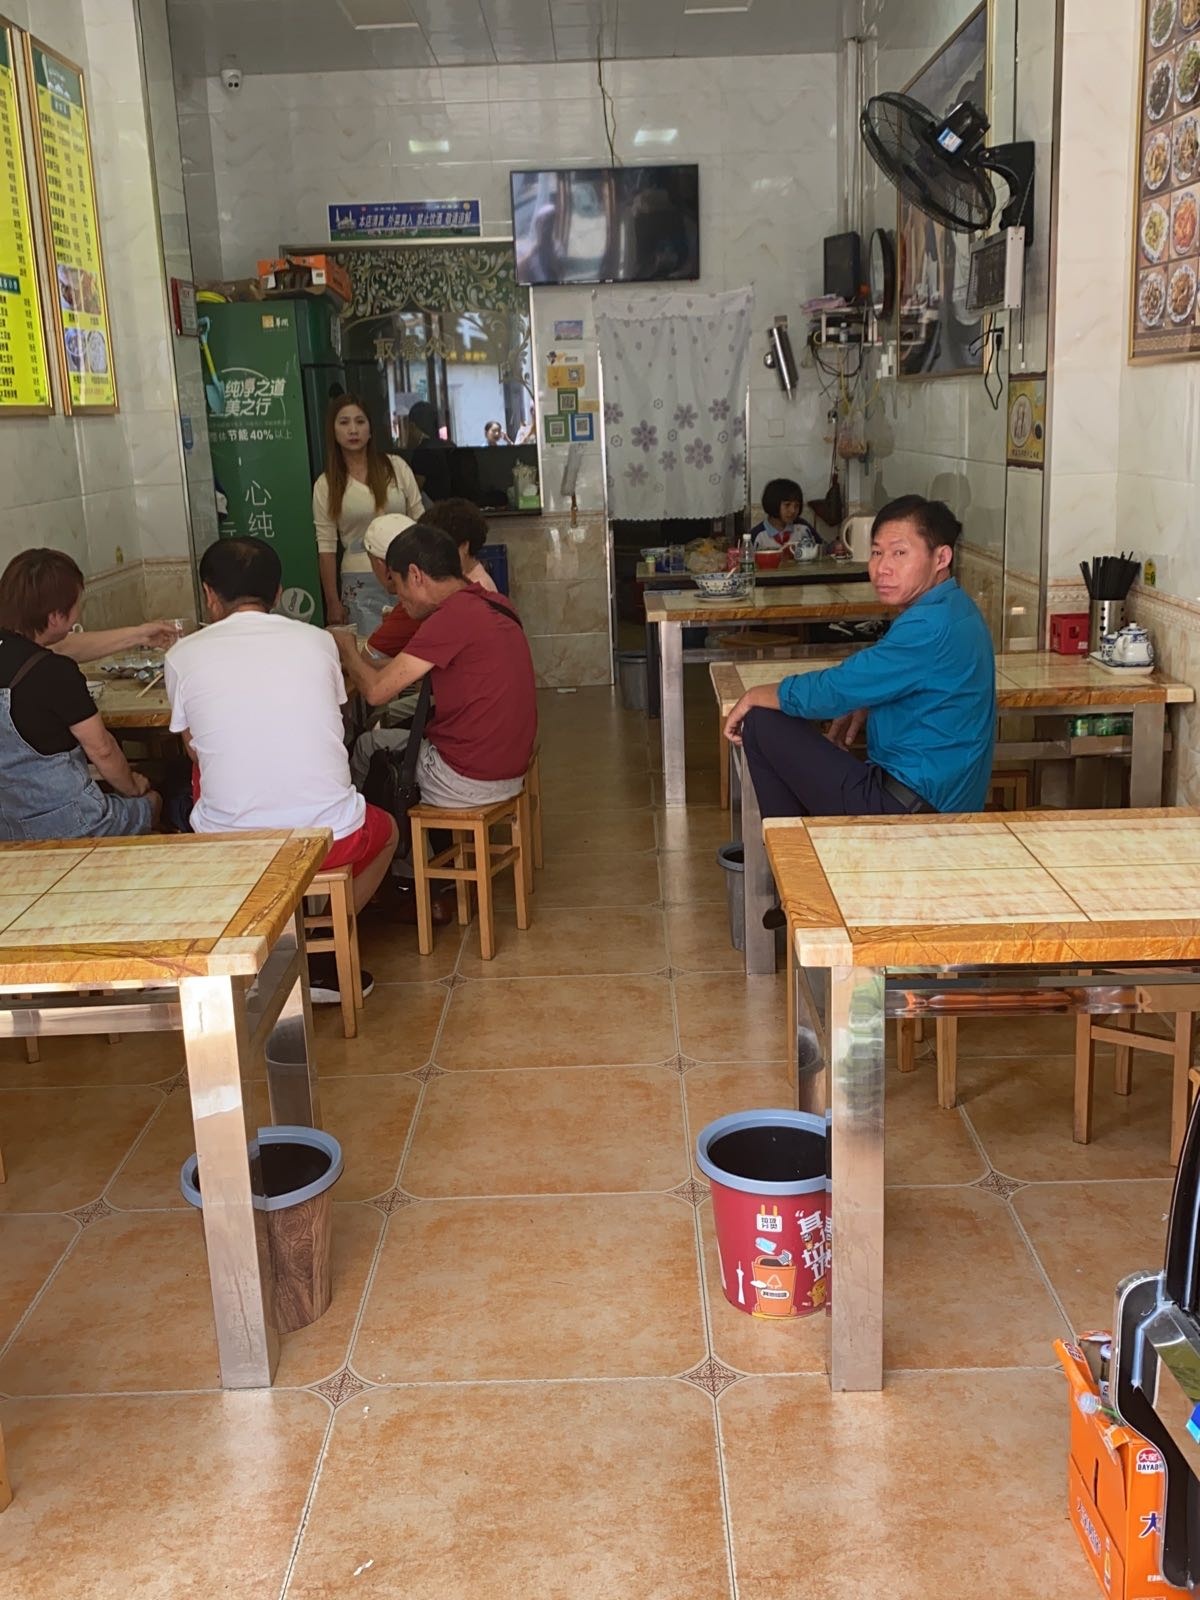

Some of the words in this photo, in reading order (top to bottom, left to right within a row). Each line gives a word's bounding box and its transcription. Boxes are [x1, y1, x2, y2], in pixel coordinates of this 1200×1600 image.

[224, 378, 286, 399] 纯净之道
[224, 398, 271, 416] 美之行
